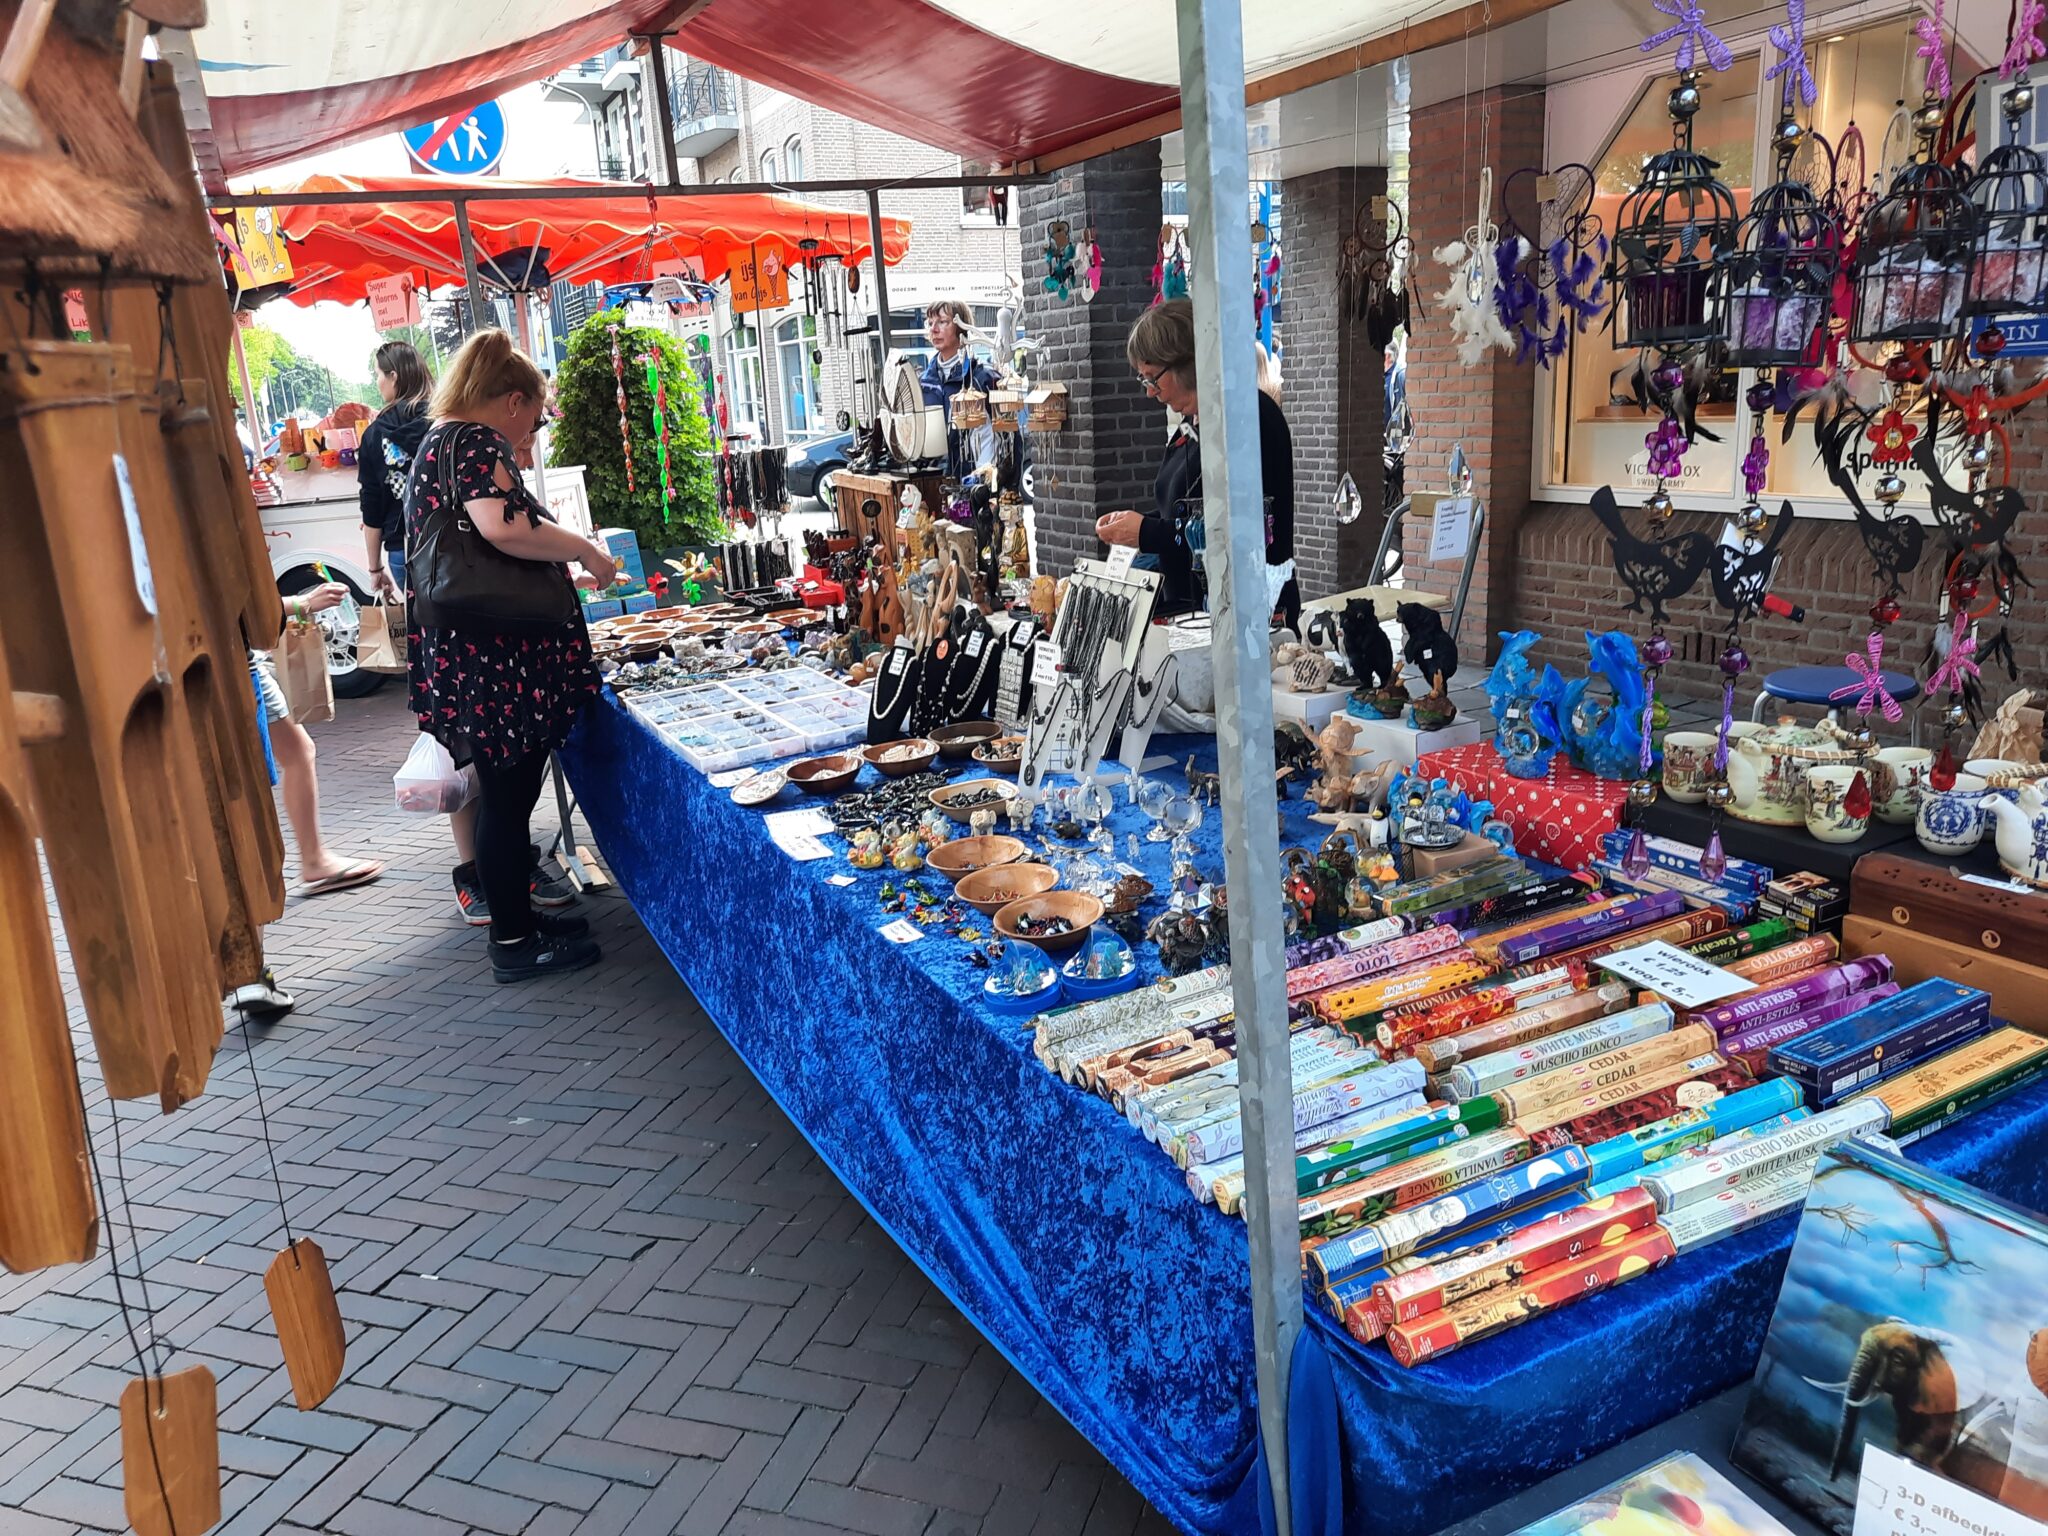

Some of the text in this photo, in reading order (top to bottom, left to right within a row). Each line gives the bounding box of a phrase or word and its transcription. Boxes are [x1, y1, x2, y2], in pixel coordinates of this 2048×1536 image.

[734, 292, 748, 301] van
[1662, 480, 1686, 488] ARMY
[1687, 936, 1737, 955] Eucalyp
[1355, 955, 1390, 973] LOTO
[1628, 966, 1660, 982] voor
[1656, 962, 1688, 977] 1,25
[1657, 950, 1714, 976] wierook
[1398, 989, 1468, 1015] CITRONELLA
[1734, 988, 1797, 1017] ANTI-STRESS
[1510, 1010, 1550, 1030] MUSK
[1739, 1000, 1801, 1032] ANTI-ESTRÉS
[1515, 1023, 1552, 1042] MUSK
[1535, 1036, 1573, 1056] WHITE
[1574, 1025, 1608, 1046] MUSK
[1743, 1018, 1808, 1048] ANTI-STRESS
[1531, 1051, 1580, 1075] MUSCHIO
[1582, 1036, 1621, 1058] BIANCO
[1588, 1051, 1632, 1071] CEDAR
[1597, 1065, 1636, 1086] CEDAR
[1599, 1082, 1642, 1102] CEDAR
[1723, 1139, 1782, 1168] MUSCHIO
[1783, 1122, 1828, 1147] BIANCO
[1455, 1157, 1498, 1180] VANILLA
[1745, 1156, 1784, 1179] WHITE
[1785, 1144, 1818, 1166] MUSK
[1408, 1172, 1453, 1196] ORANGE
[1735, 1172, 1779, 1195] WHITE
[1781, 1160, 1813, 1182] MUSK
[1894, 1508, 1904, 1521] €
[1896, 1485, 2006, 1536] 3-D afbeel
